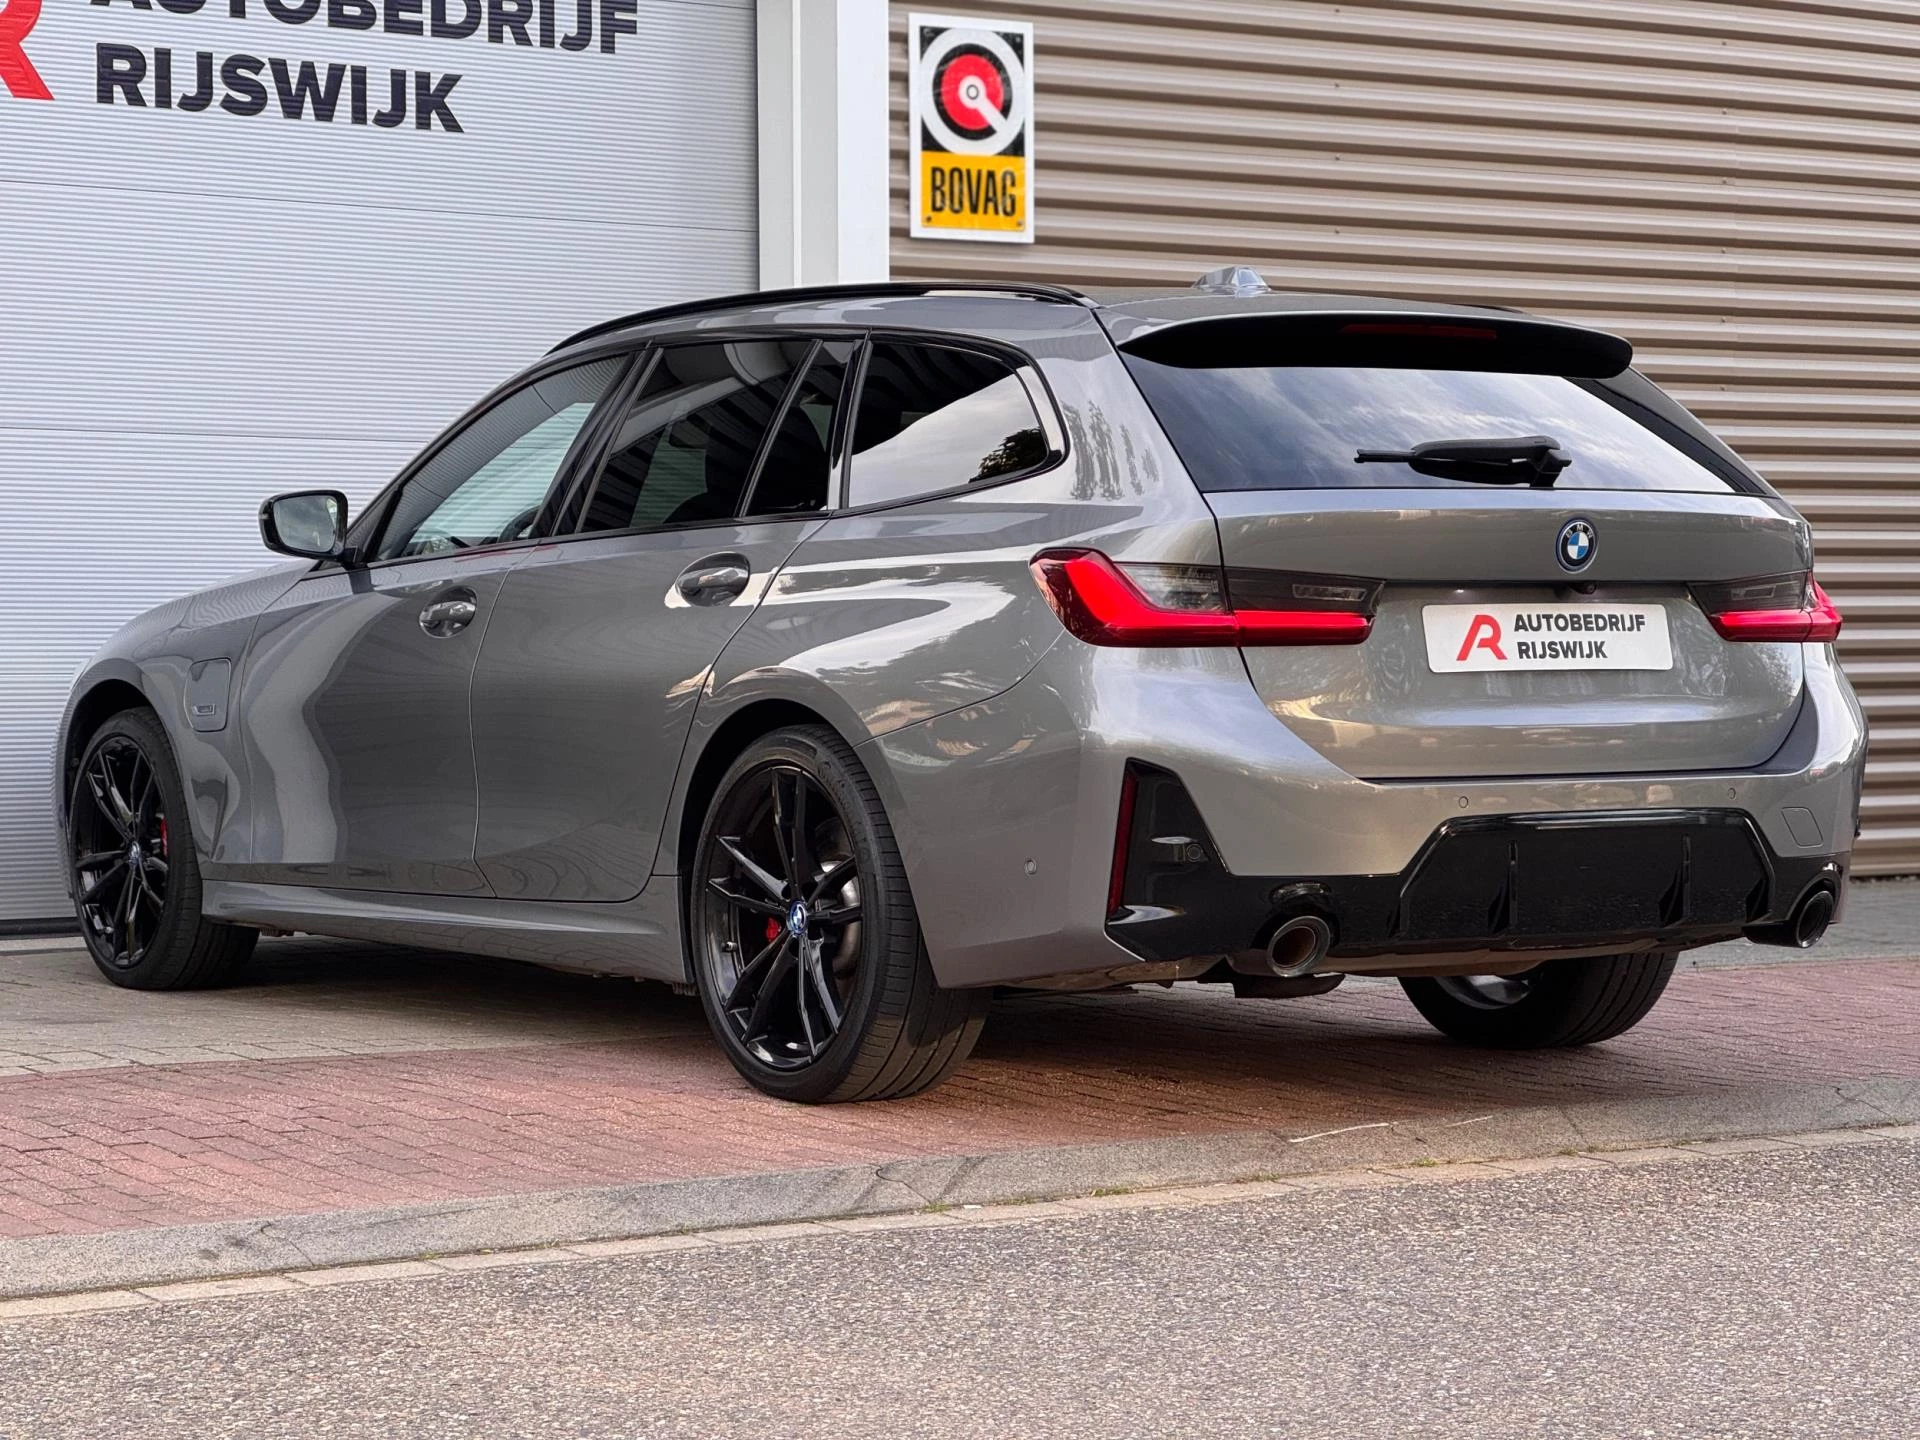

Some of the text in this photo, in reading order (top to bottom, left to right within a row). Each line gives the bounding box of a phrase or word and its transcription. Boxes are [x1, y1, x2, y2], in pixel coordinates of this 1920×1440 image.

[96, 42, 465, 133] RIJSWIJK
[931, 166, 1017, 217] BOVAG
[1514, 613, 1646, 632] AUTOBEDRIJF
[1517, 640, 1608, 659] RIJSWIJK
